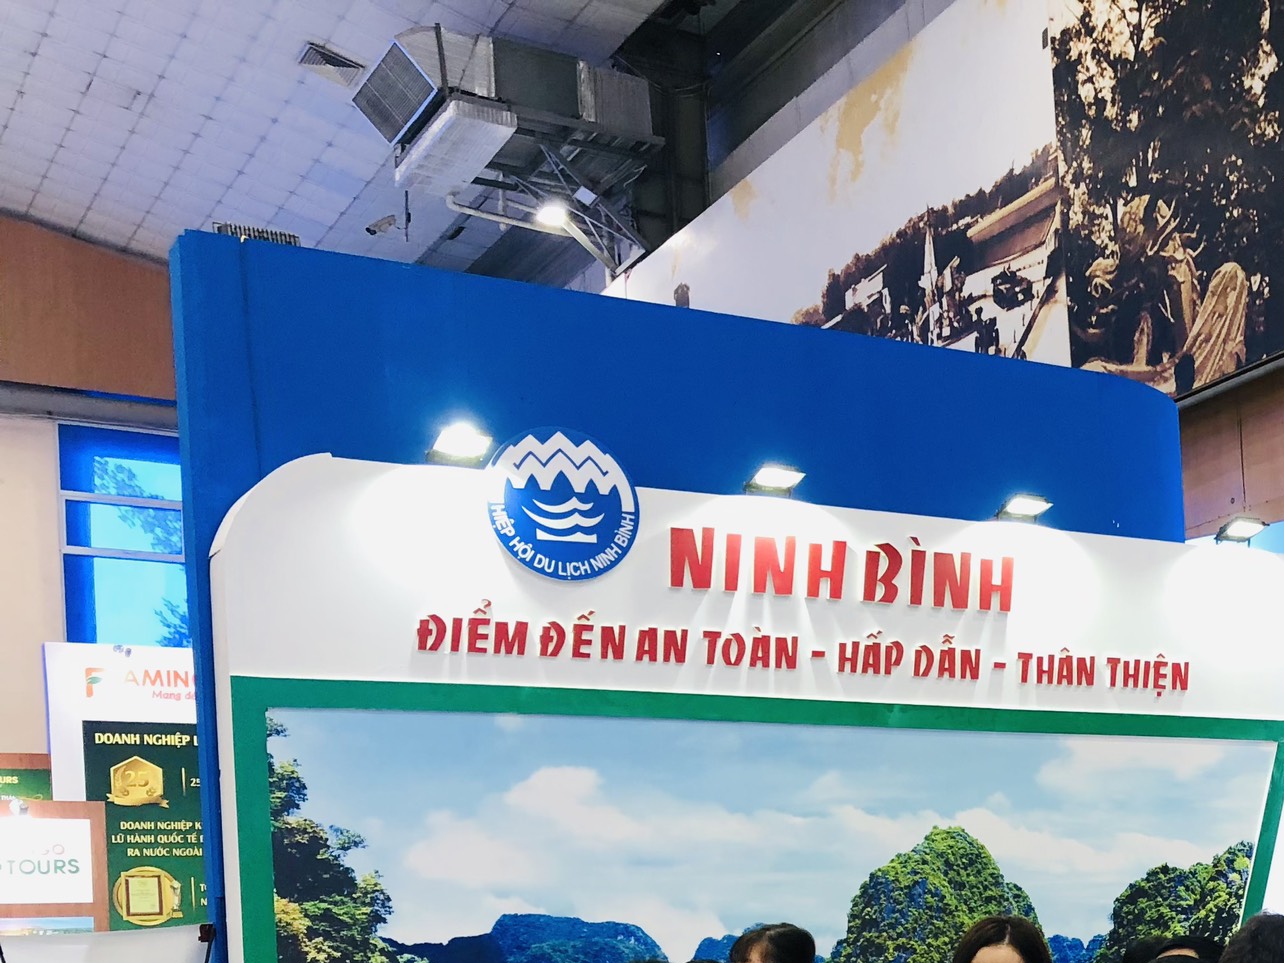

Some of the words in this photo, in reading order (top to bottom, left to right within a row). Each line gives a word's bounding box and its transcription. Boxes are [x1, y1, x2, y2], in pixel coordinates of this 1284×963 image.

[490, 504, 515, 537] HIỆP
[509, 536, 535, 562] HỘI
[533, 553, 555, 573] DU
[558, 560, 591, 580] LỊCH
[589, 543, 622, 572] NINH
[614, 513, 635, 548] BÌNH
[669, 527, 847, 600] NINH
[861, 536, 1014, 612] BÌNH
[416, 598, 528, 656] ĐIỂM
[539, 610, 627, 660] ĐẾN
[635, 627, 689, 663] AN
[702, 626, 799, 670] TOÀN
[838, 630, 904, 676] HẤP
[913, 633, 981, 680] DẪN
[1017, 647, 1096, 686] THÂN
[1106, 653, 1190, 697] THIỆN
[94, 732, 140, 745] DOANH
[143, 731, 190, 748] NGHIỆP
[125, 770, 149, 788] 25
[120, 821, 155, 830] DOANH
[157, 819, 193, 831] NGHIỆP
[127, 832, 155, 844] HÀNH
[157, 831, 184, 844] QUỐC
[186, 831, 198, 843] TẾ
[127, 848, 140, 857] RA
[143, 846, 170, 857] NƯỚC
[172, 846, 202, 857] NGOÀI
[7, 858, 80, 875] TOURS
